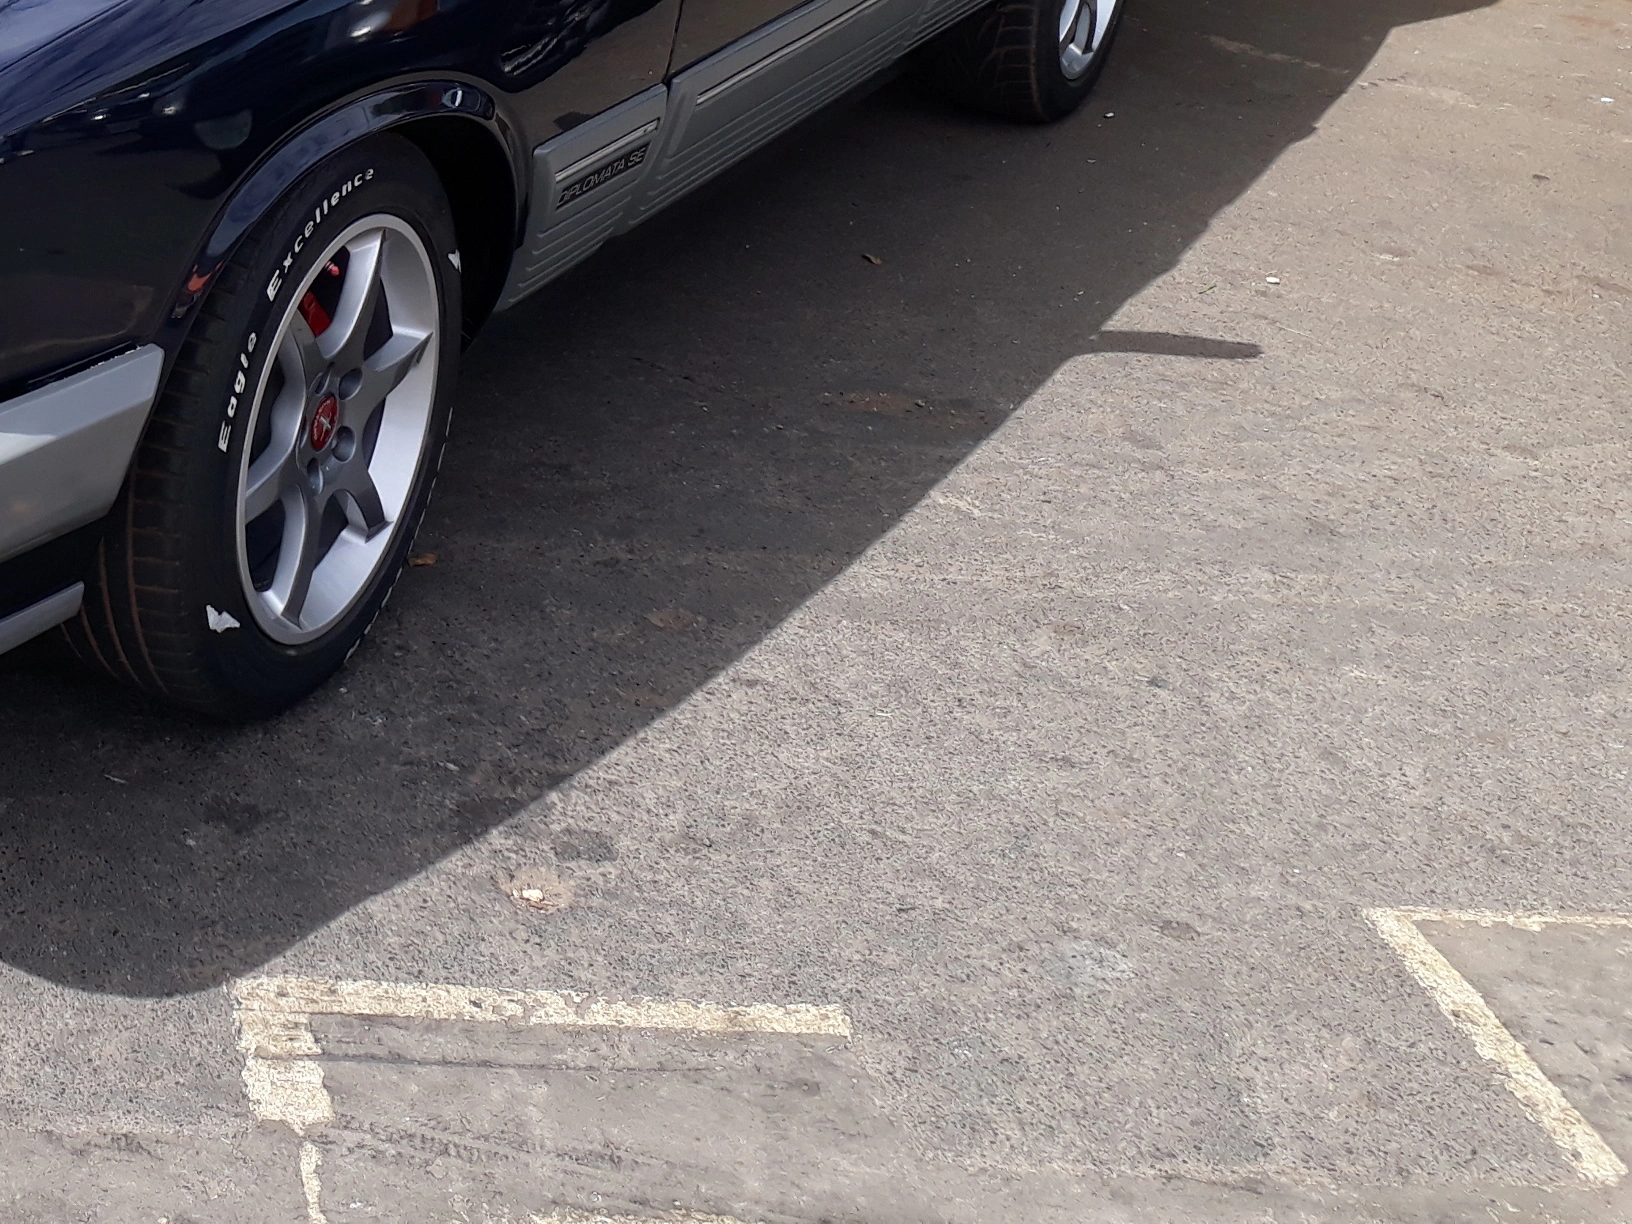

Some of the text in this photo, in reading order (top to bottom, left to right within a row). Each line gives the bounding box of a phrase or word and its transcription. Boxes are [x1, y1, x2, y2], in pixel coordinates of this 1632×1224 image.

[557, 147, 647, 206] DIPLOMATA SE
[218, 167, 374, 453] Eagle Excellence
